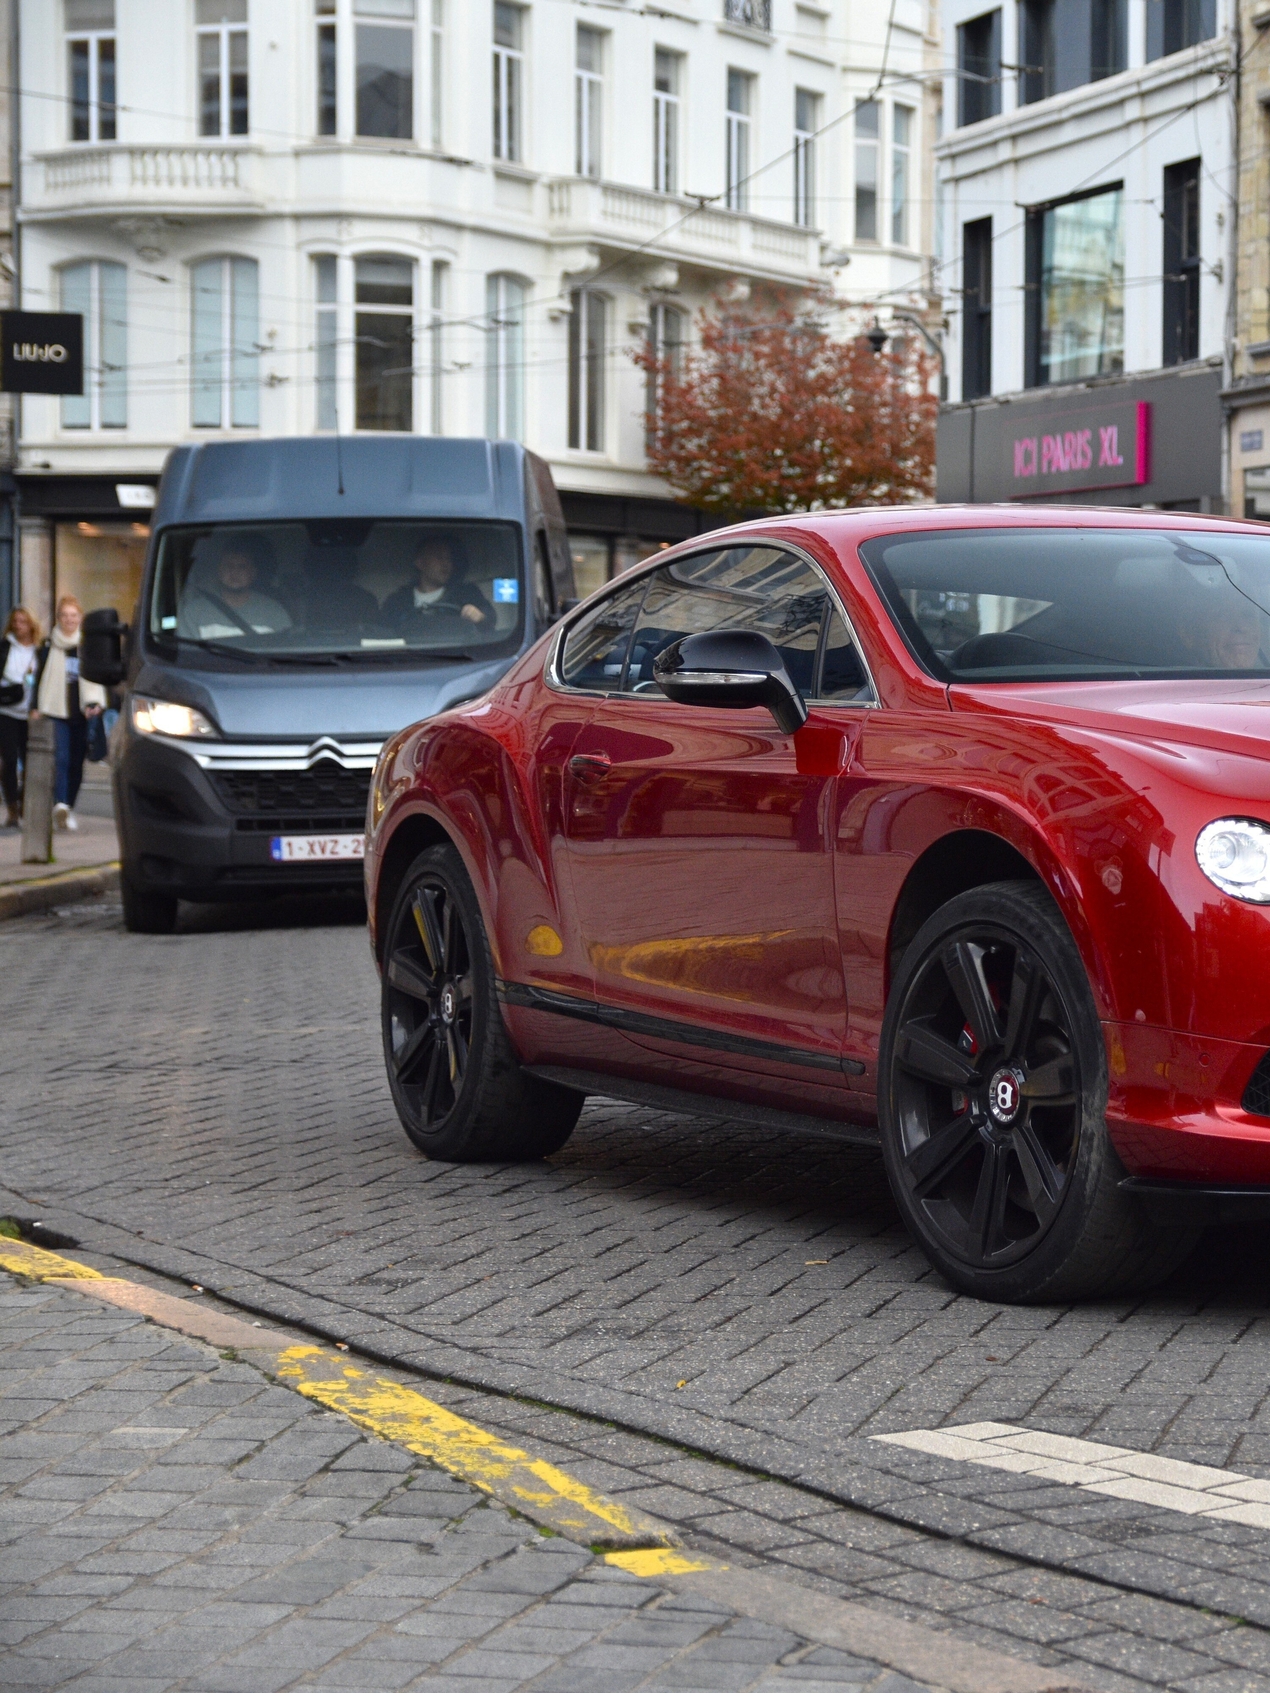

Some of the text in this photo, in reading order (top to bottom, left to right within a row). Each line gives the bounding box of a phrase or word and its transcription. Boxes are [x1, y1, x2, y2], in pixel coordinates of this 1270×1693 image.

[1013, 425, 1123, 477] ICI PARIS XL
[285, 838, 364, 856] 1-XVZ-2
